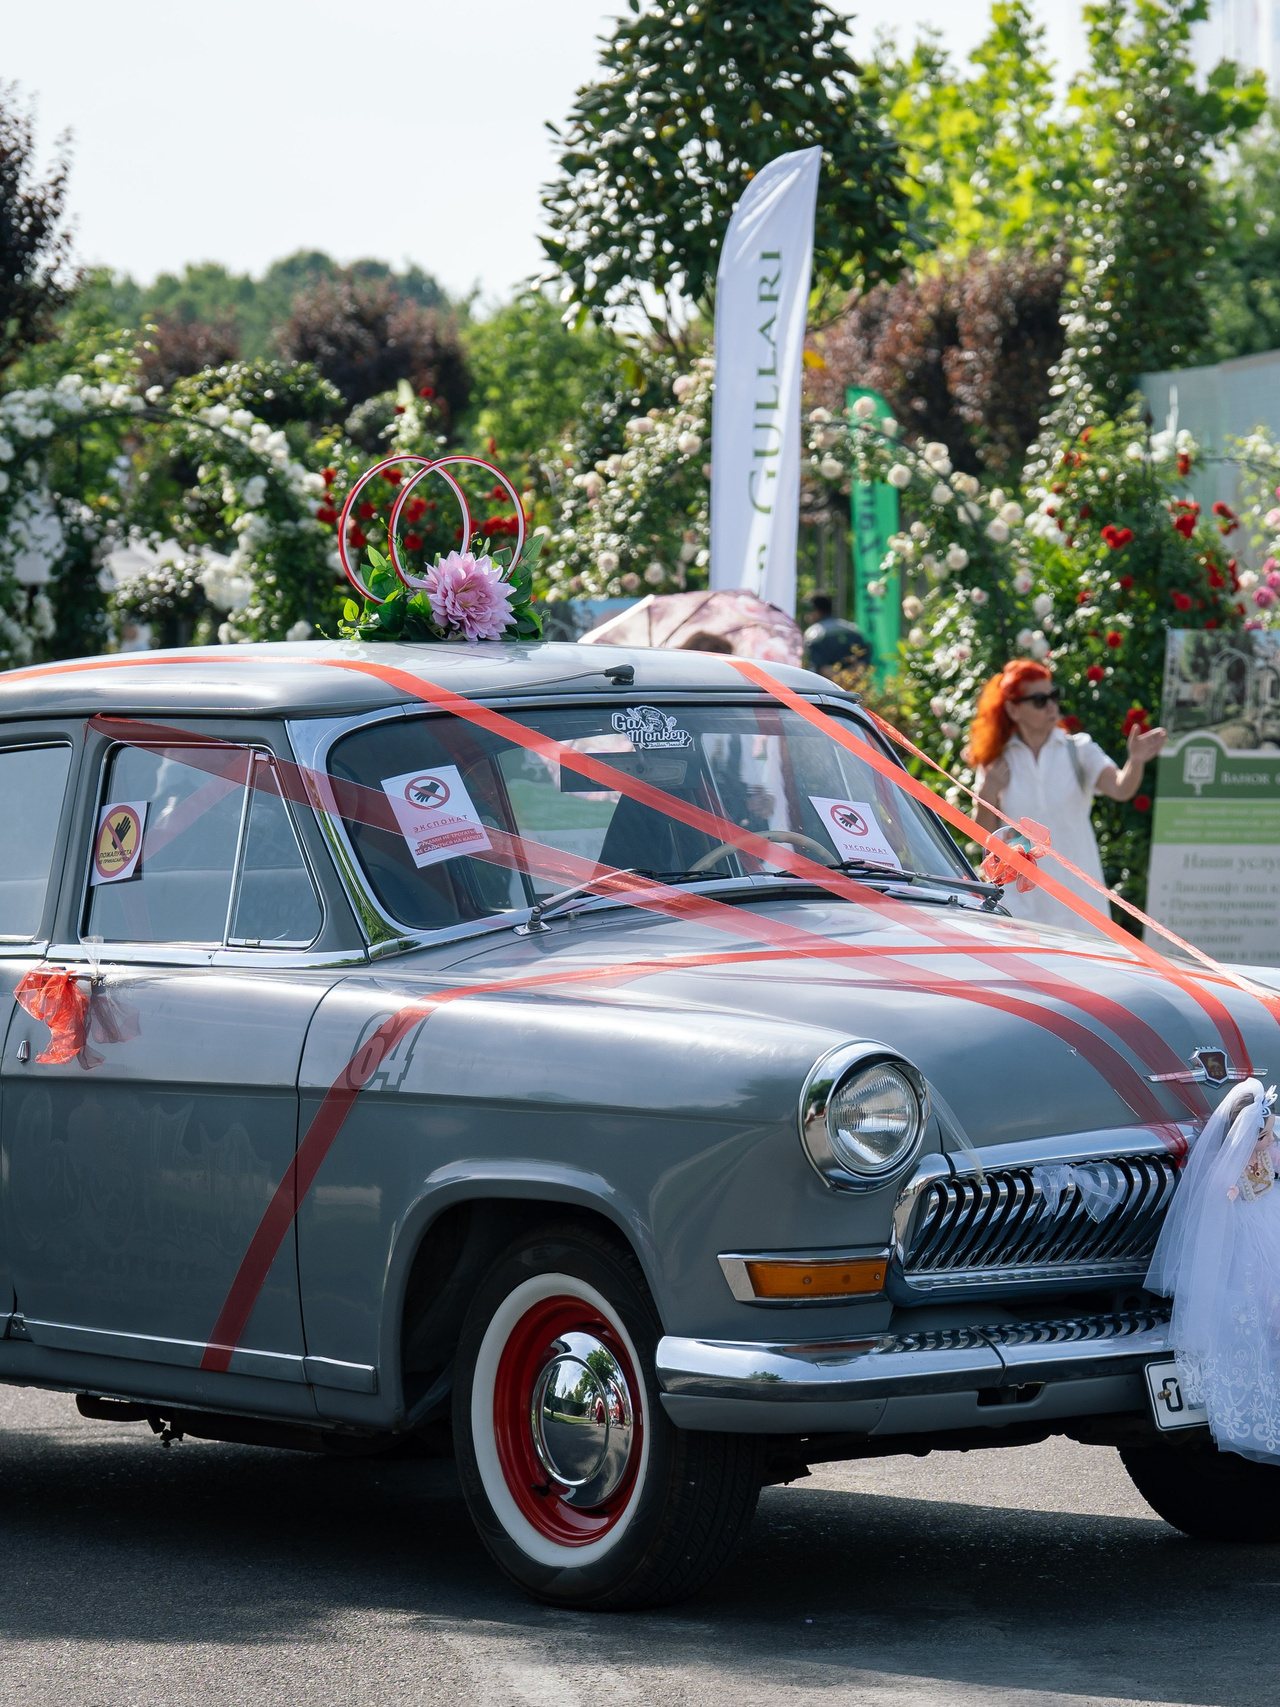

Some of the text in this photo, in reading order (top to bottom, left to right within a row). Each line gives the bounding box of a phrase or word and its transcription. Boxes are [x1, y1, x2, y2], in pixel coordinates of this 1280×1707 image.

[749, 250, 783, 514] GULLARI
[613, 714, 648, 732] Gas
[627, 728, 688, 745] Monkey
[1221, 771, 1270, 786] BAHOR
[413, 814, 467, 833] ЭКСПОНАТ
[842, 843, 889, 854] ЭКСПОНАТ
[346, 1009, 434, 1092] 64
